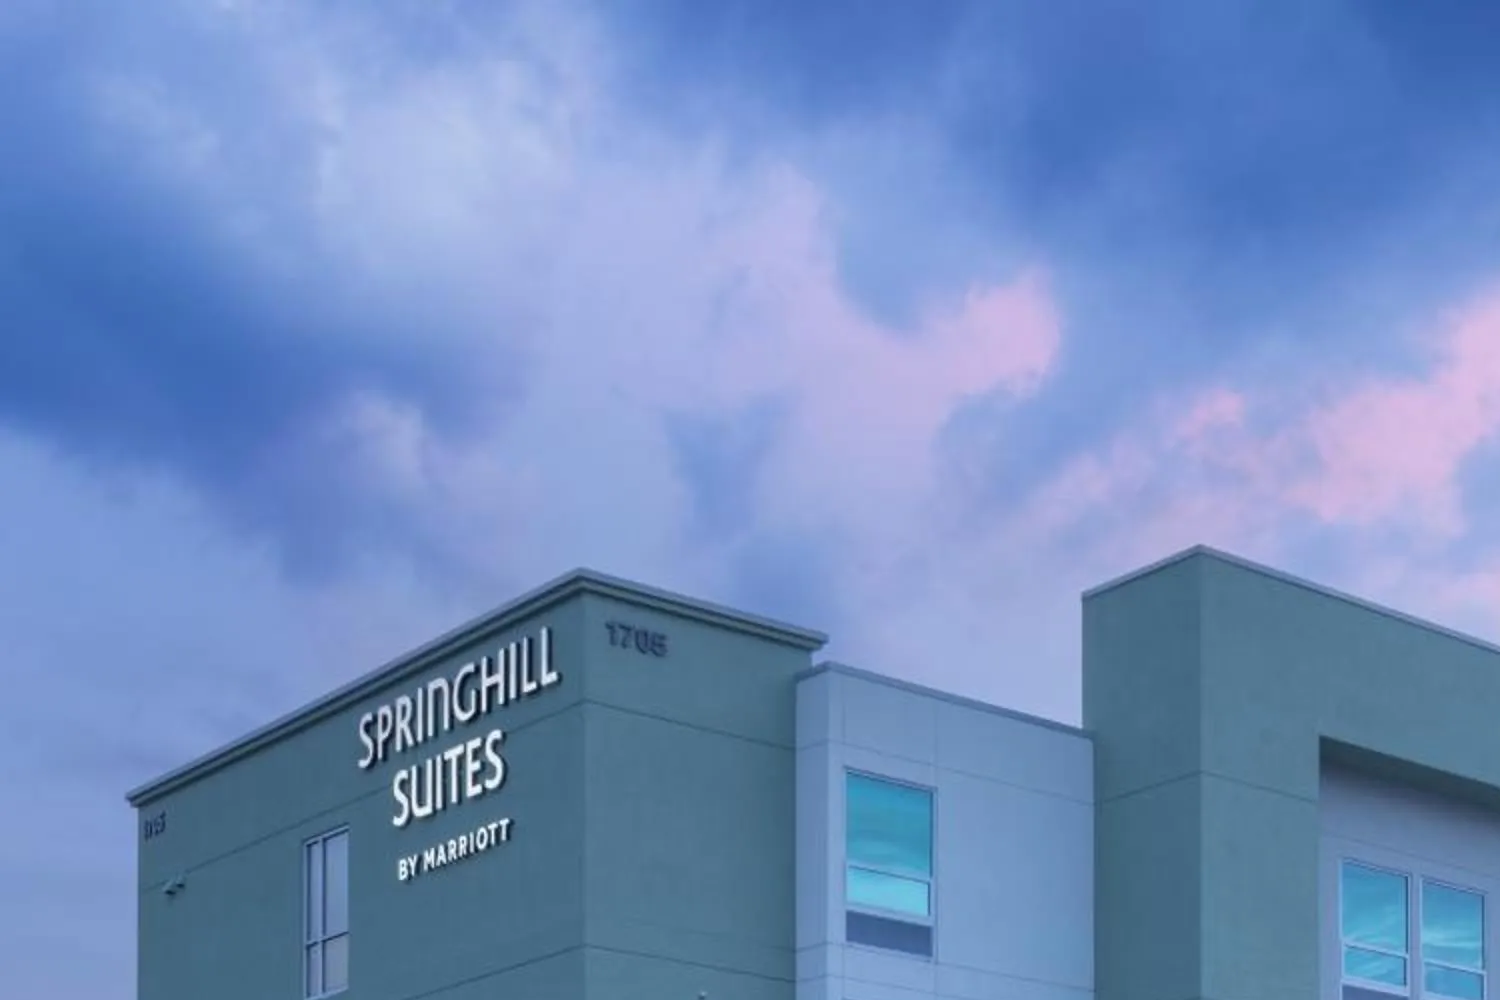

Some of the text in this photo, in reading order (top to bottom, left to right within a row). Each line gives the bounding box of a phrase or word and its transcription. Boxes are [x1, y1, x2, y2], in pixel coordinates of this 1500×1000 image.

[357, 625, 559, 769] SPRINGHILL
[392, 729, 505, 827] SUITES
[398, 817, 511, 881] BY MARRIOTT
